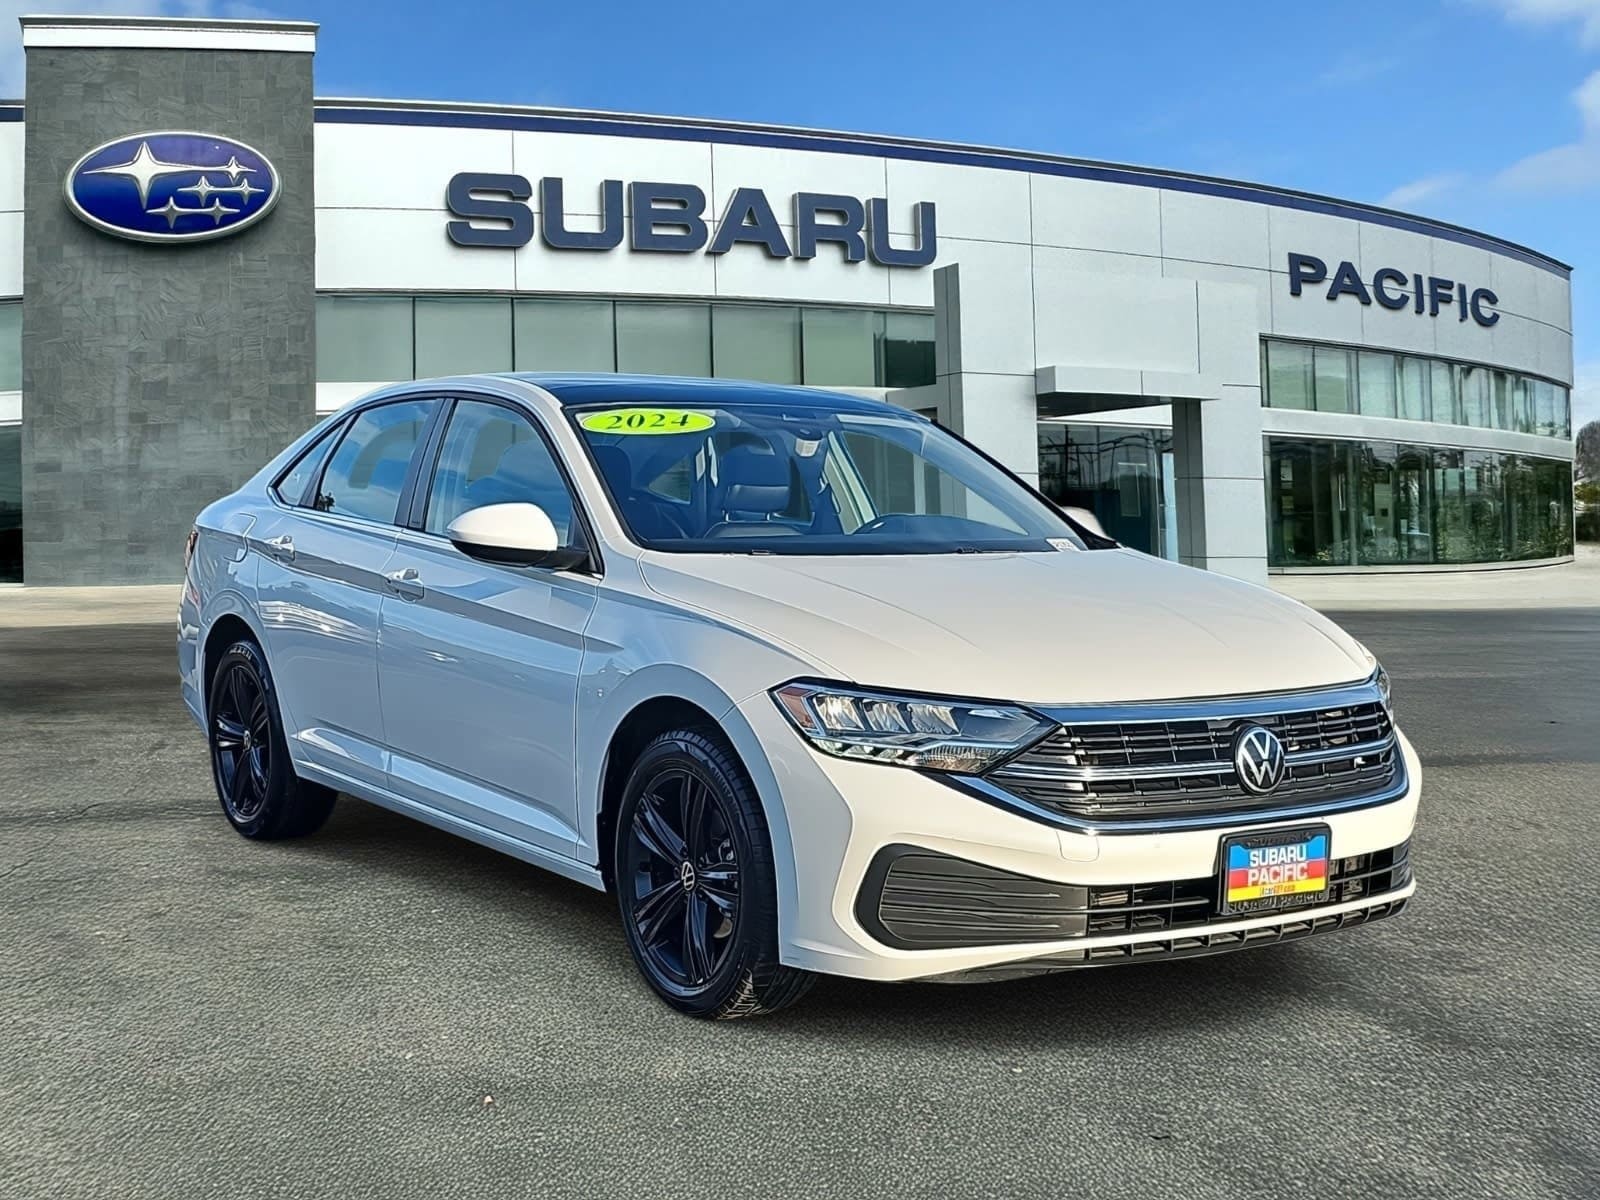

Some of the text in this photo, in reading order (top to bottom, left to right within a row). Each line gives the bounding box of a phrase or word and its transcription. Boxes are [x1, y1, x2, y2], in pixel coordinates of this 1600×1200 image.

[446, 171, 938, 269] SUBARU
[1287, 251, 1501, 327] PACIFIC
[605, 413, 689, 430] 2024
[1249, 843, 1307, 868] SUBARU
[1247, 862, 1309, 887] PACIFIC
